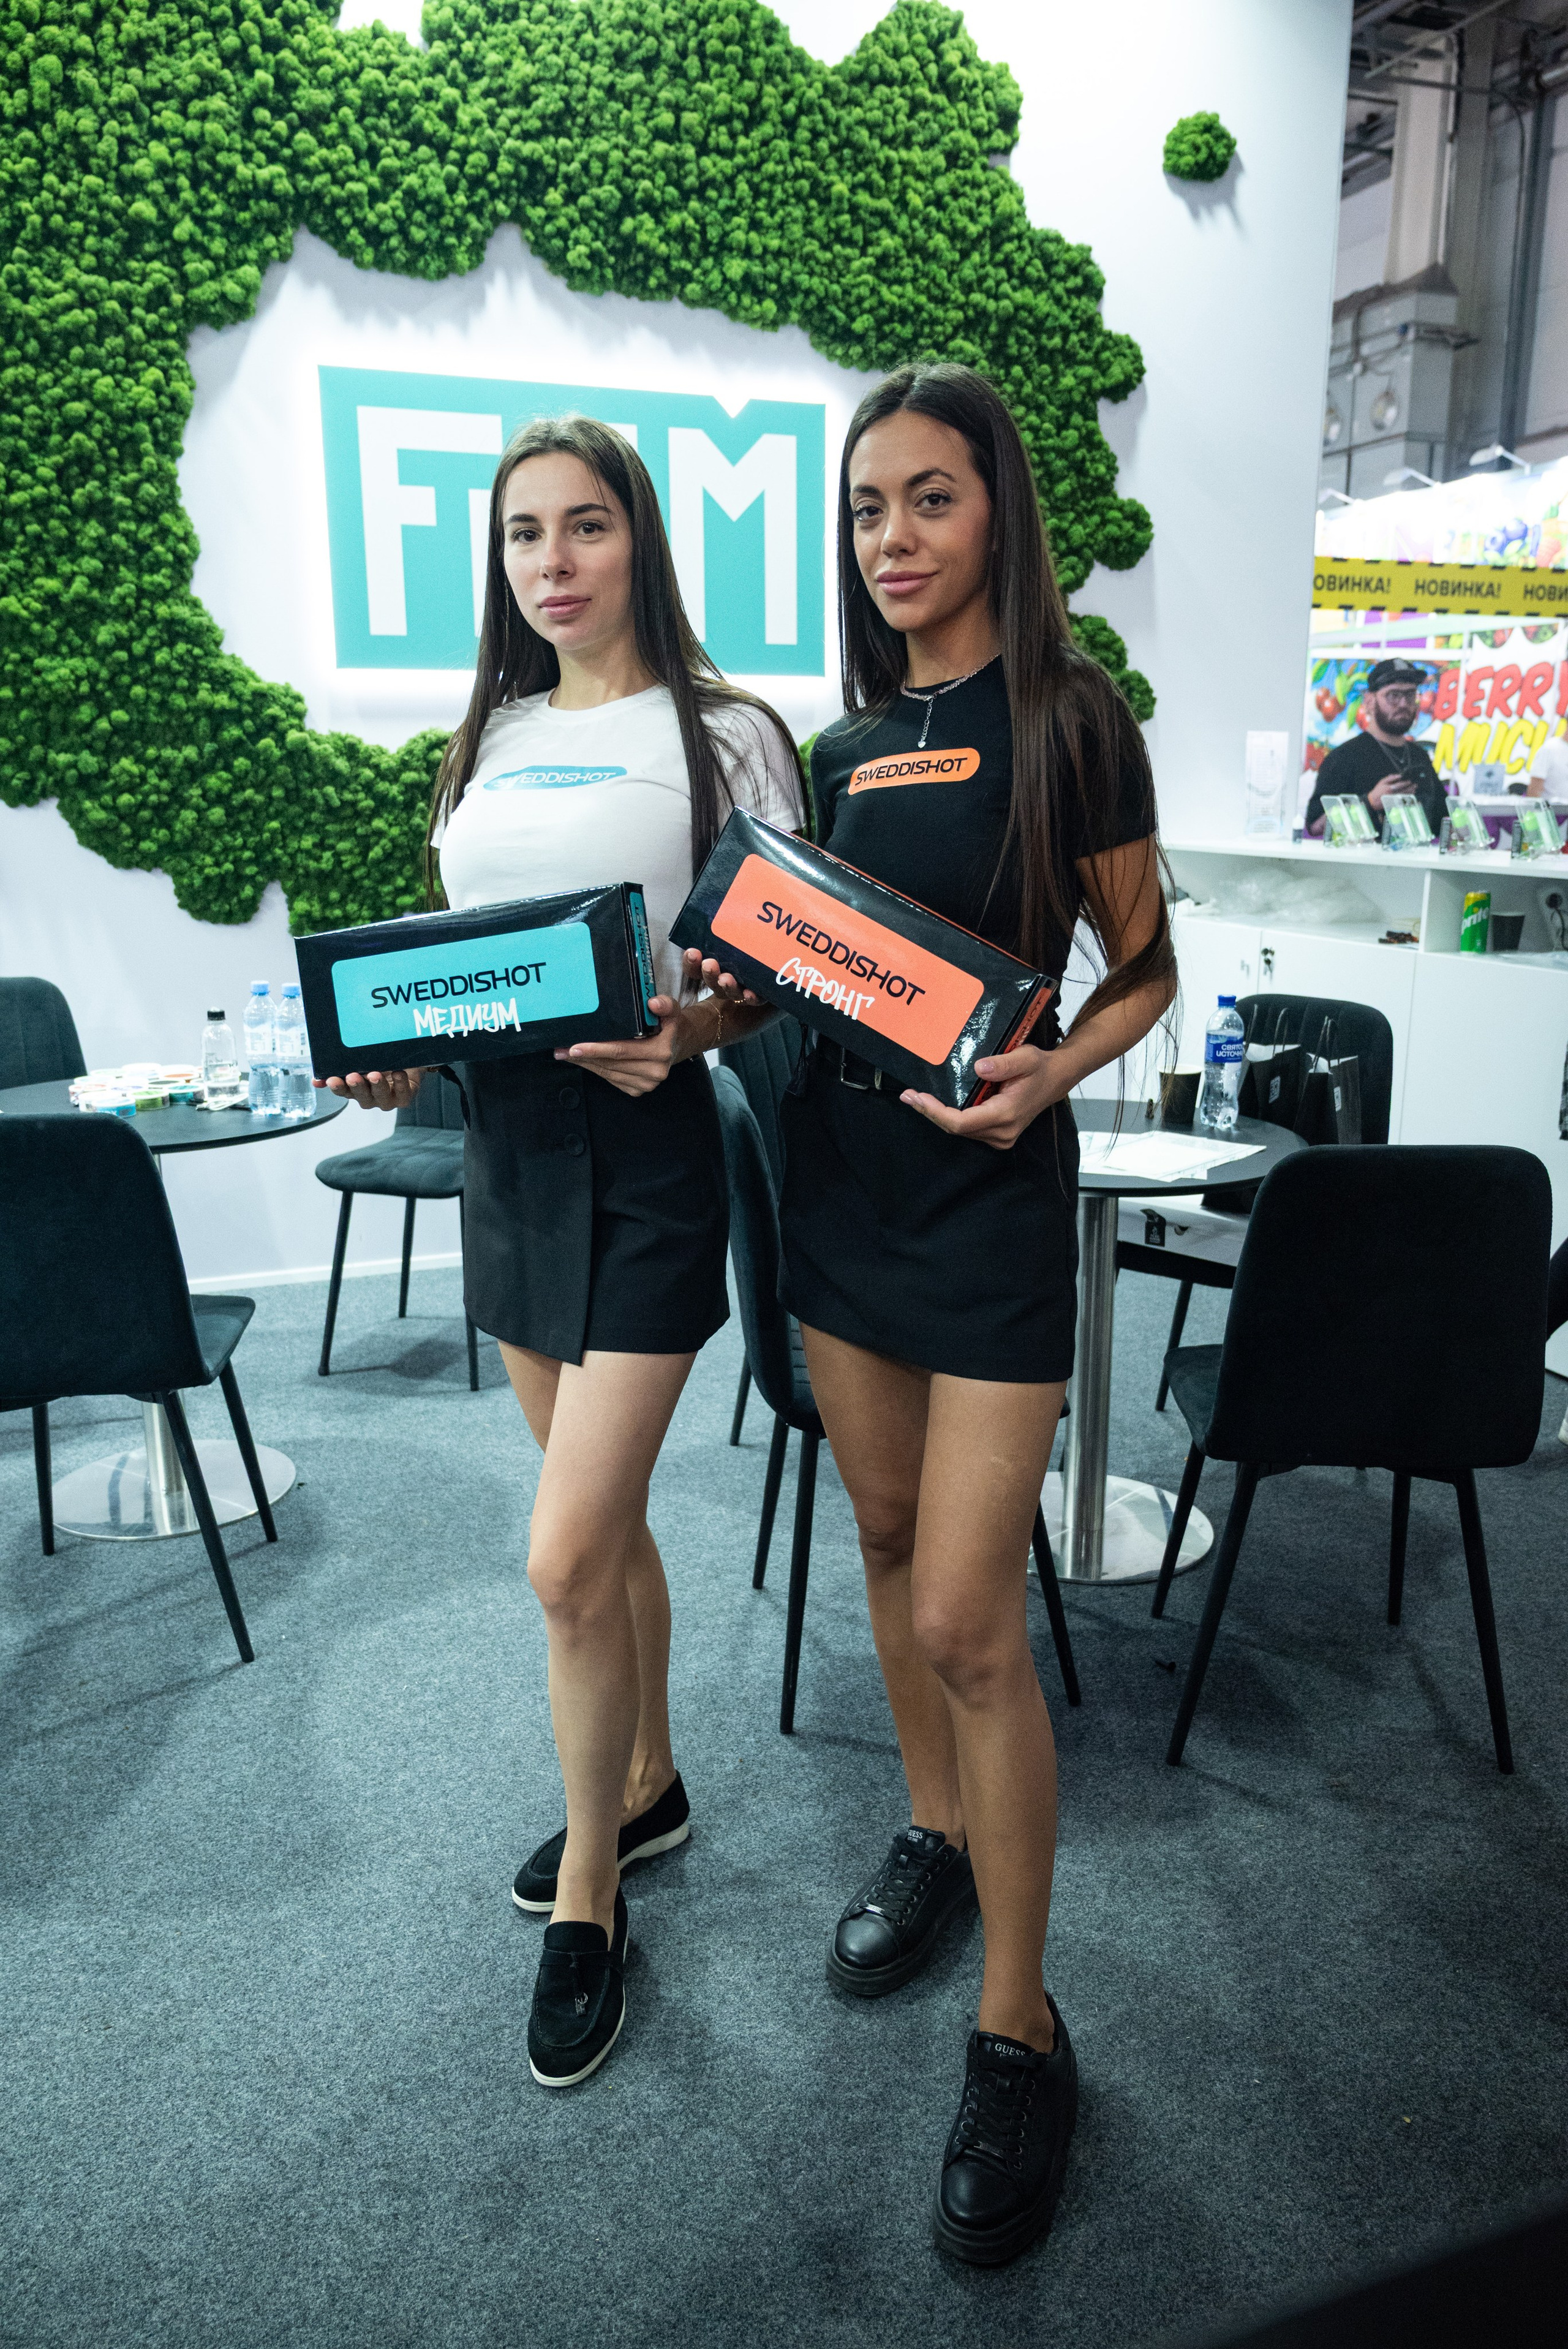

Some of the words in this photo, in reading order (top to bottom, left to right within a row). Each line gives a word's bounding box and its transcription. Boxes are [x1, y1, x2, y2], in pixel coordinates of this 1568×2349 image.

[1313, 574, 1392, 594] ОВИНКА!
[1414, 578, 1502, 599] НОВИНКА!
[494, 772, 616, 790] SWEDDISHOT
[855, 757, 968, 786] SWEDDISHOT
[634, 902, 651, 998] WEDDISHOT
[757, 901, 925, 1006] SWEDDISHOT
[371, 962, 547, 1009] SWEDDISHOT
[775, 957, 875, 1020] СТРОНГ
[413, 997, 522, 1038] МЕДИУМ
